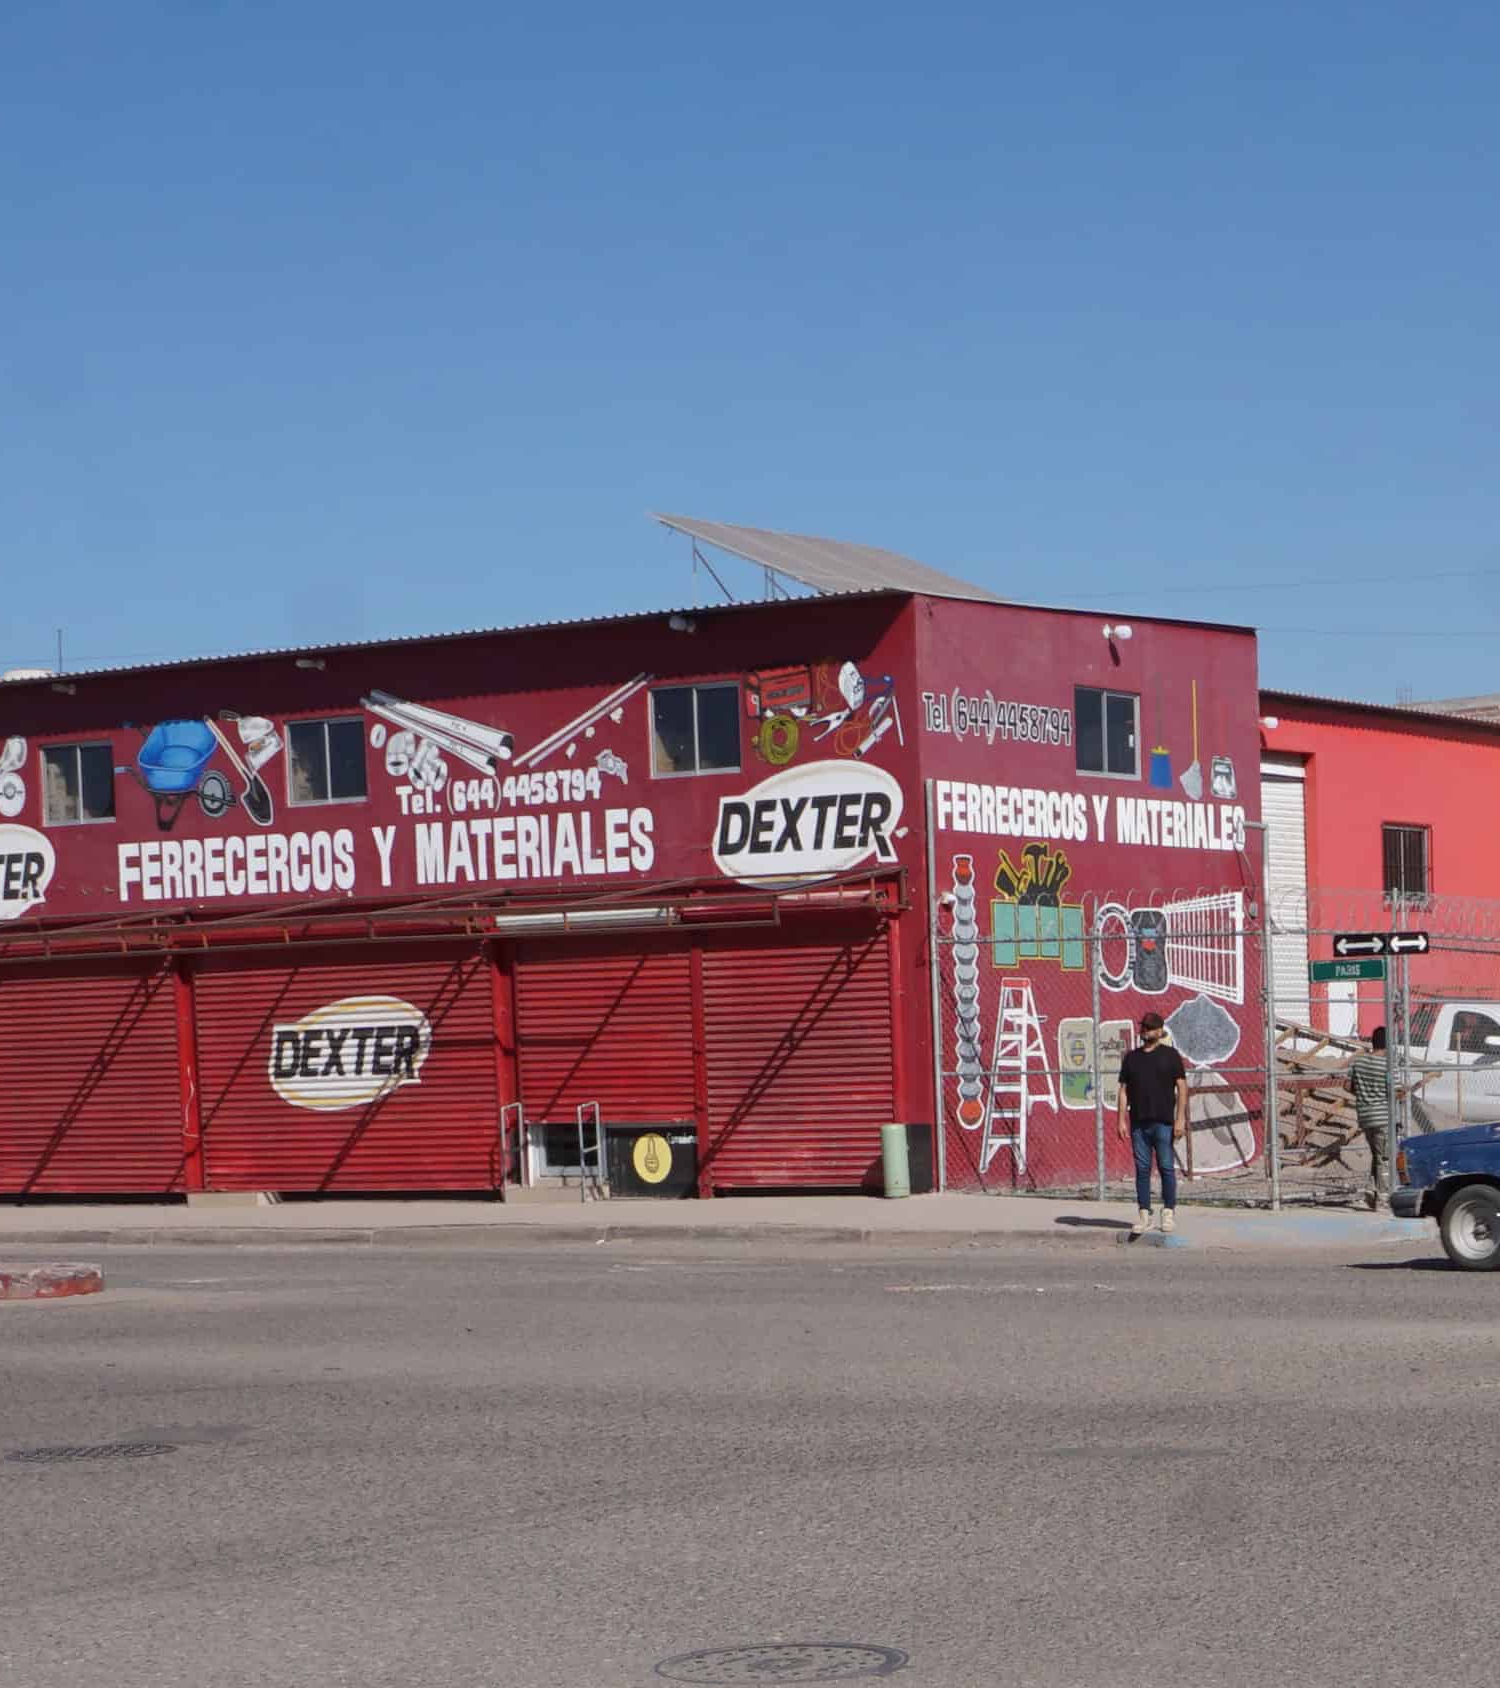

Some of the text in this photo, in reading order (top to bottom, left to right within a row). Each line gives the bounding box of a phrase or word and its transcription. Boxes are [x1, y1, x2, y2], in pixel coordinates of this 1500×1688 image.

[922, 691, 952, 733] Tel.
[395, 784, 442, 815] Tel.
[717, 791, 896, 863] DEXTER
[937, 779, 1246, 852] FERRECERCOS Y MATERIALES
[118, 807, 654, 902] FERRECERCOS Y MATERIALES
[1335, 964, 1361, 977] PARIS
[273, 1025, 421, 1080] DEXTER
